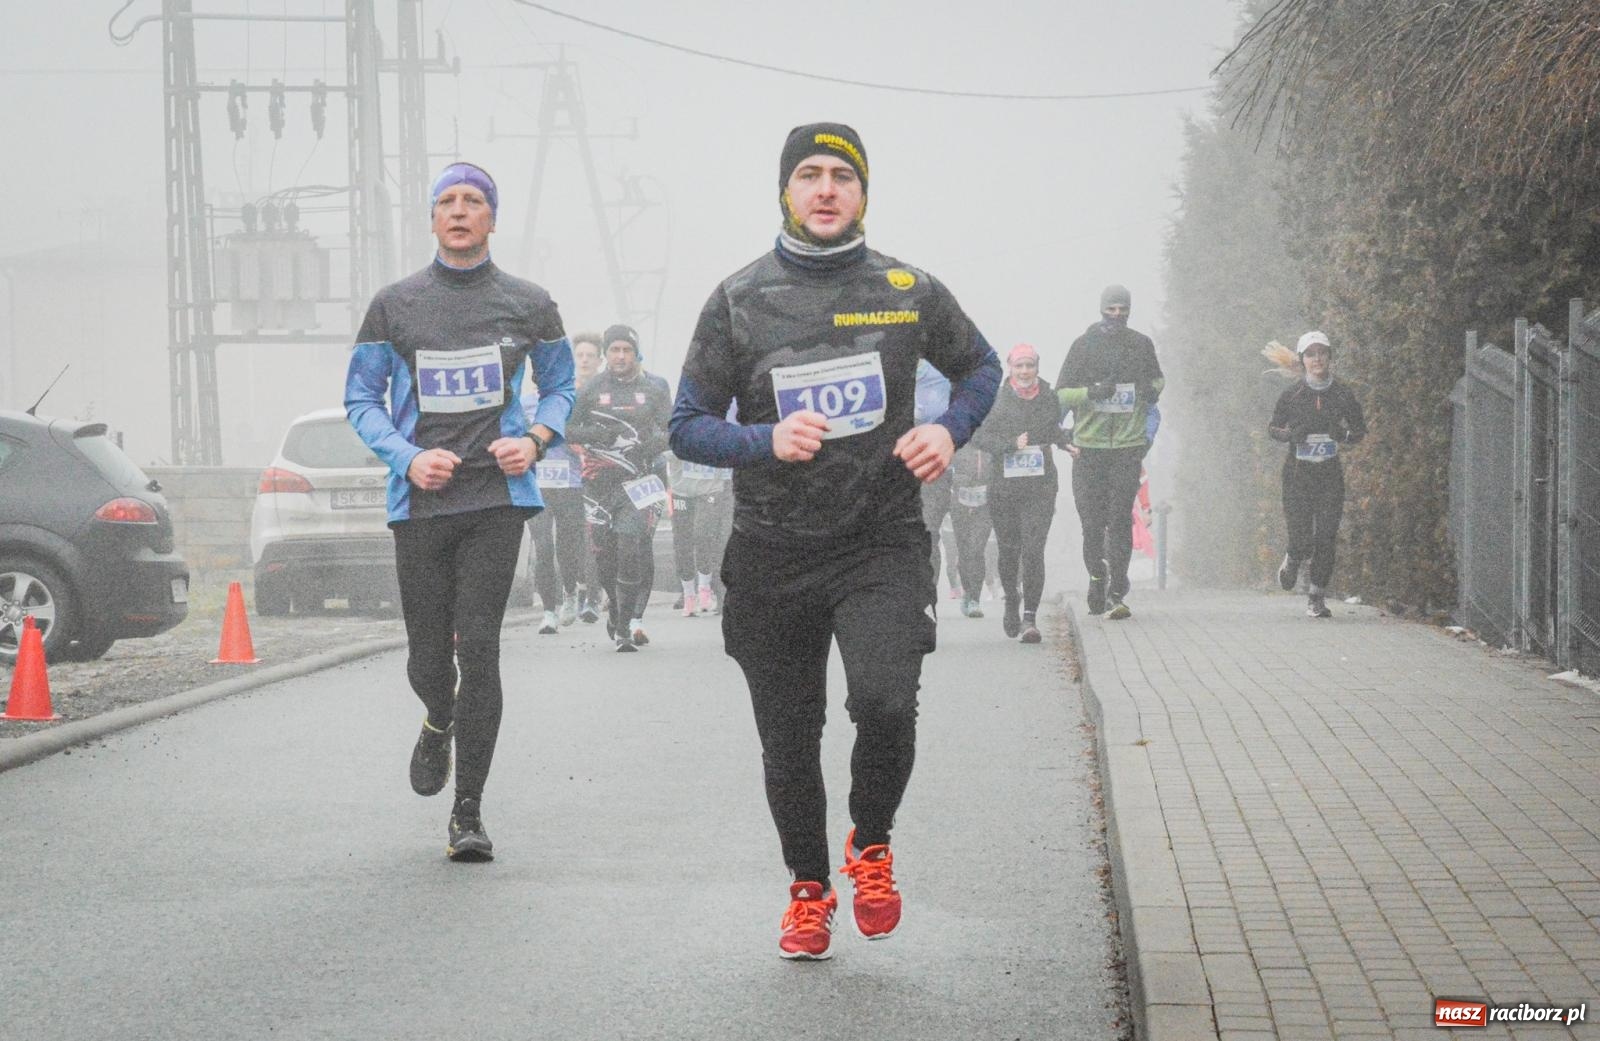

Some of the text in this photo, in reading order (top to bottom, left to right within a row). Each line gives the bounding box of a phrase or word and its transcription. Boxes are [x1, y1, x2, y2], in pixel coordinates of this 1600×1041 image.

[833, 310, 919, 327] RUNMAGEDDON
[433, 367, 489, 396] 111
[797, 380, 867, 418] 109
[1309, 443, 1326, 455] 76
[1012, 454, 1038, 468] 146
[538, 468, 562, 480] 157
[340, 491, 355, 505] SK
